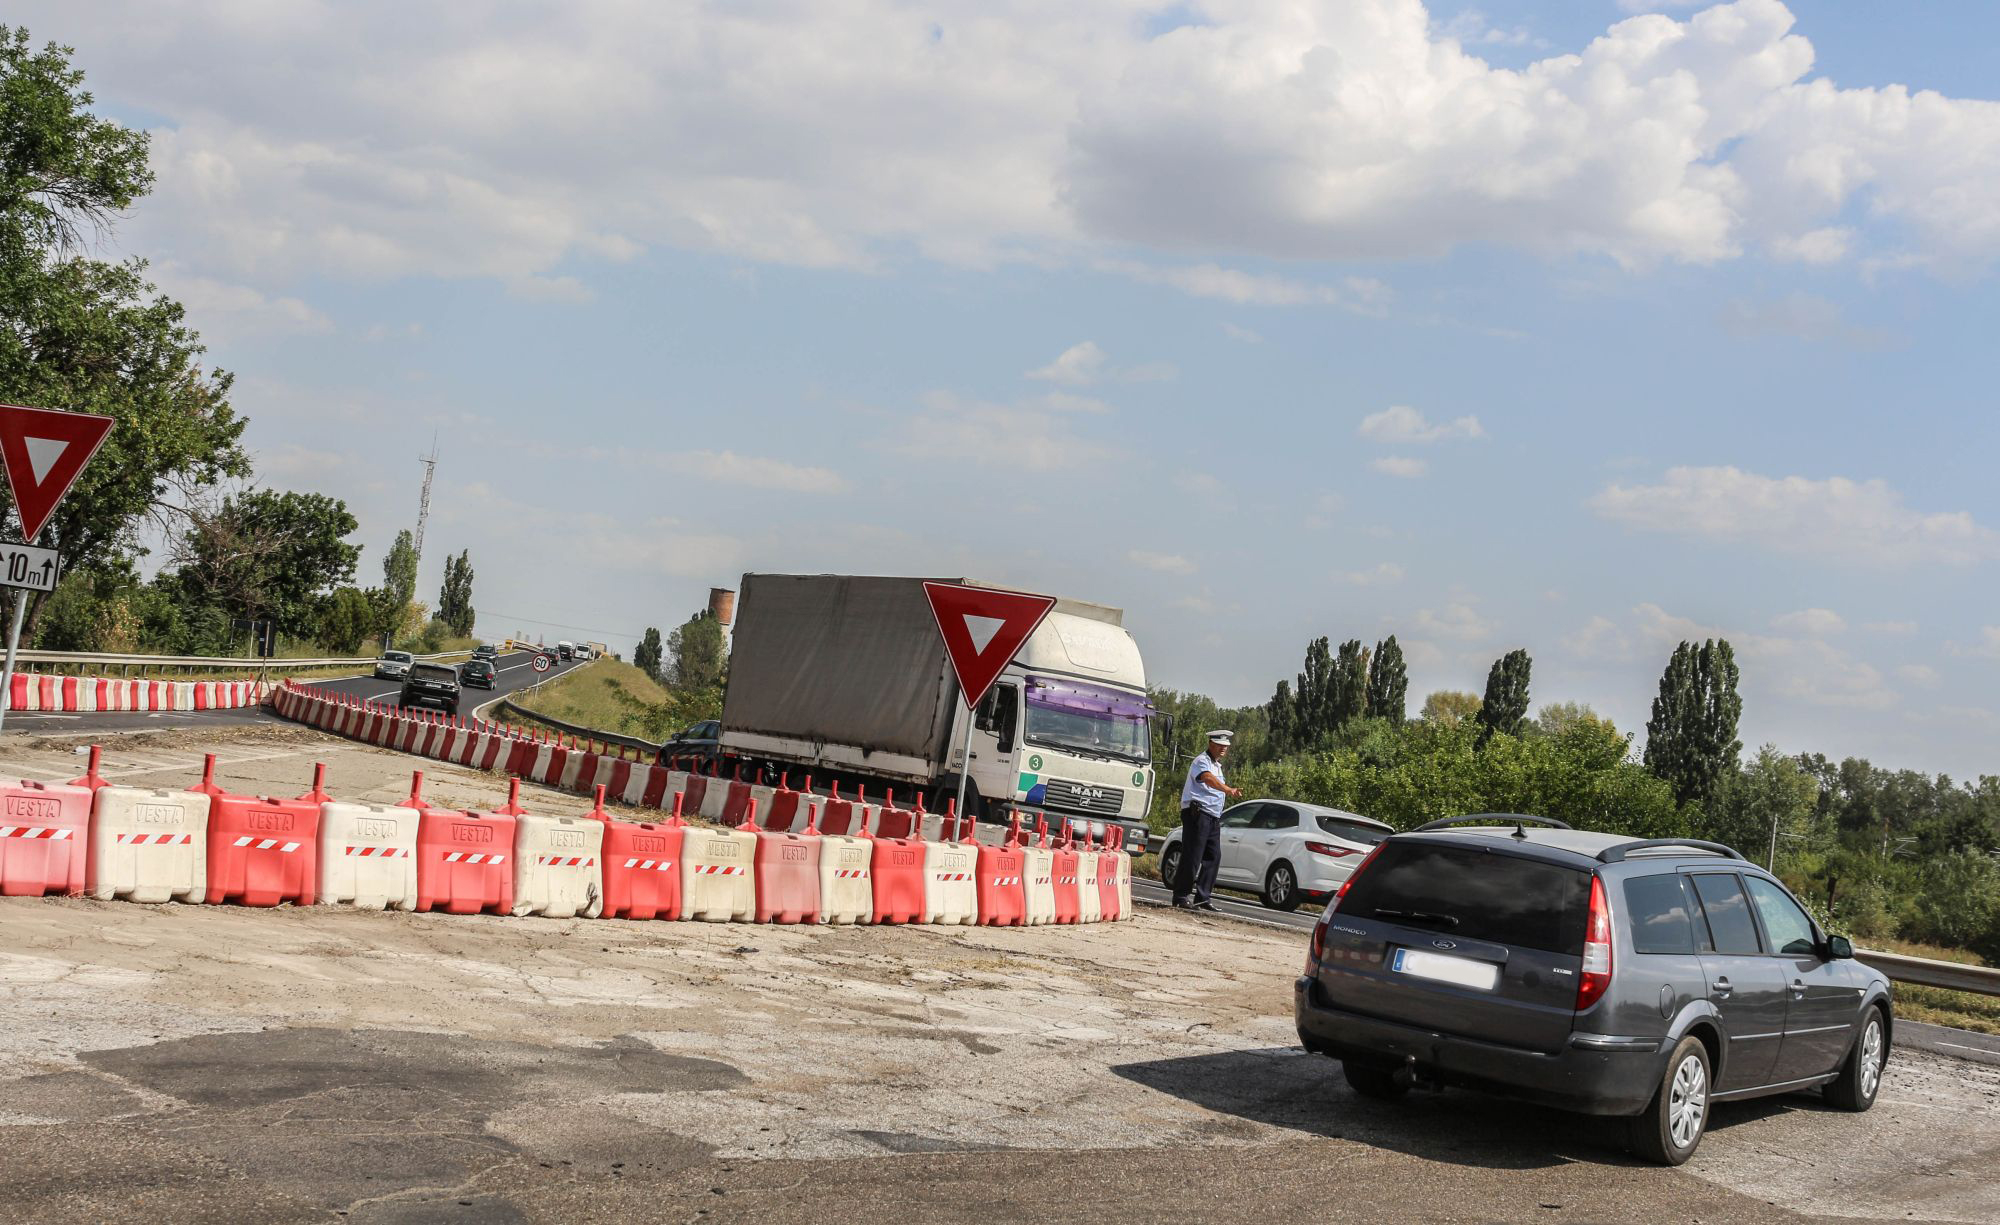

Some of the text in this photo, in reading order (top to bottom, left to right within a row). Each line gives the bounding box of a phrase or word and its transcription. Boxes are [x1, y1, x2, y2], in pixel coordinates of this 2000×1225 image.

[536, 658, 546, 668] 60
[1032, 757, 1040, 769] 3
[1135, 773, 1141, 785] L
[1070, 785, 1103, 798] MAN
[6, 798, 60, 818] VESTA
[135, 806, 181, 824] VESTA
[248, 813, 292, 831] VESTA
[356, 819, 395, 838] VESTA
[451, 825, 490, 843] VESTA
[550, 831, 583, 848] VESTA
[632, 836, 662, 853] VESTA
[708, 840, 738, 857] VESTA
[781, 846, 806, 861] VESTA
